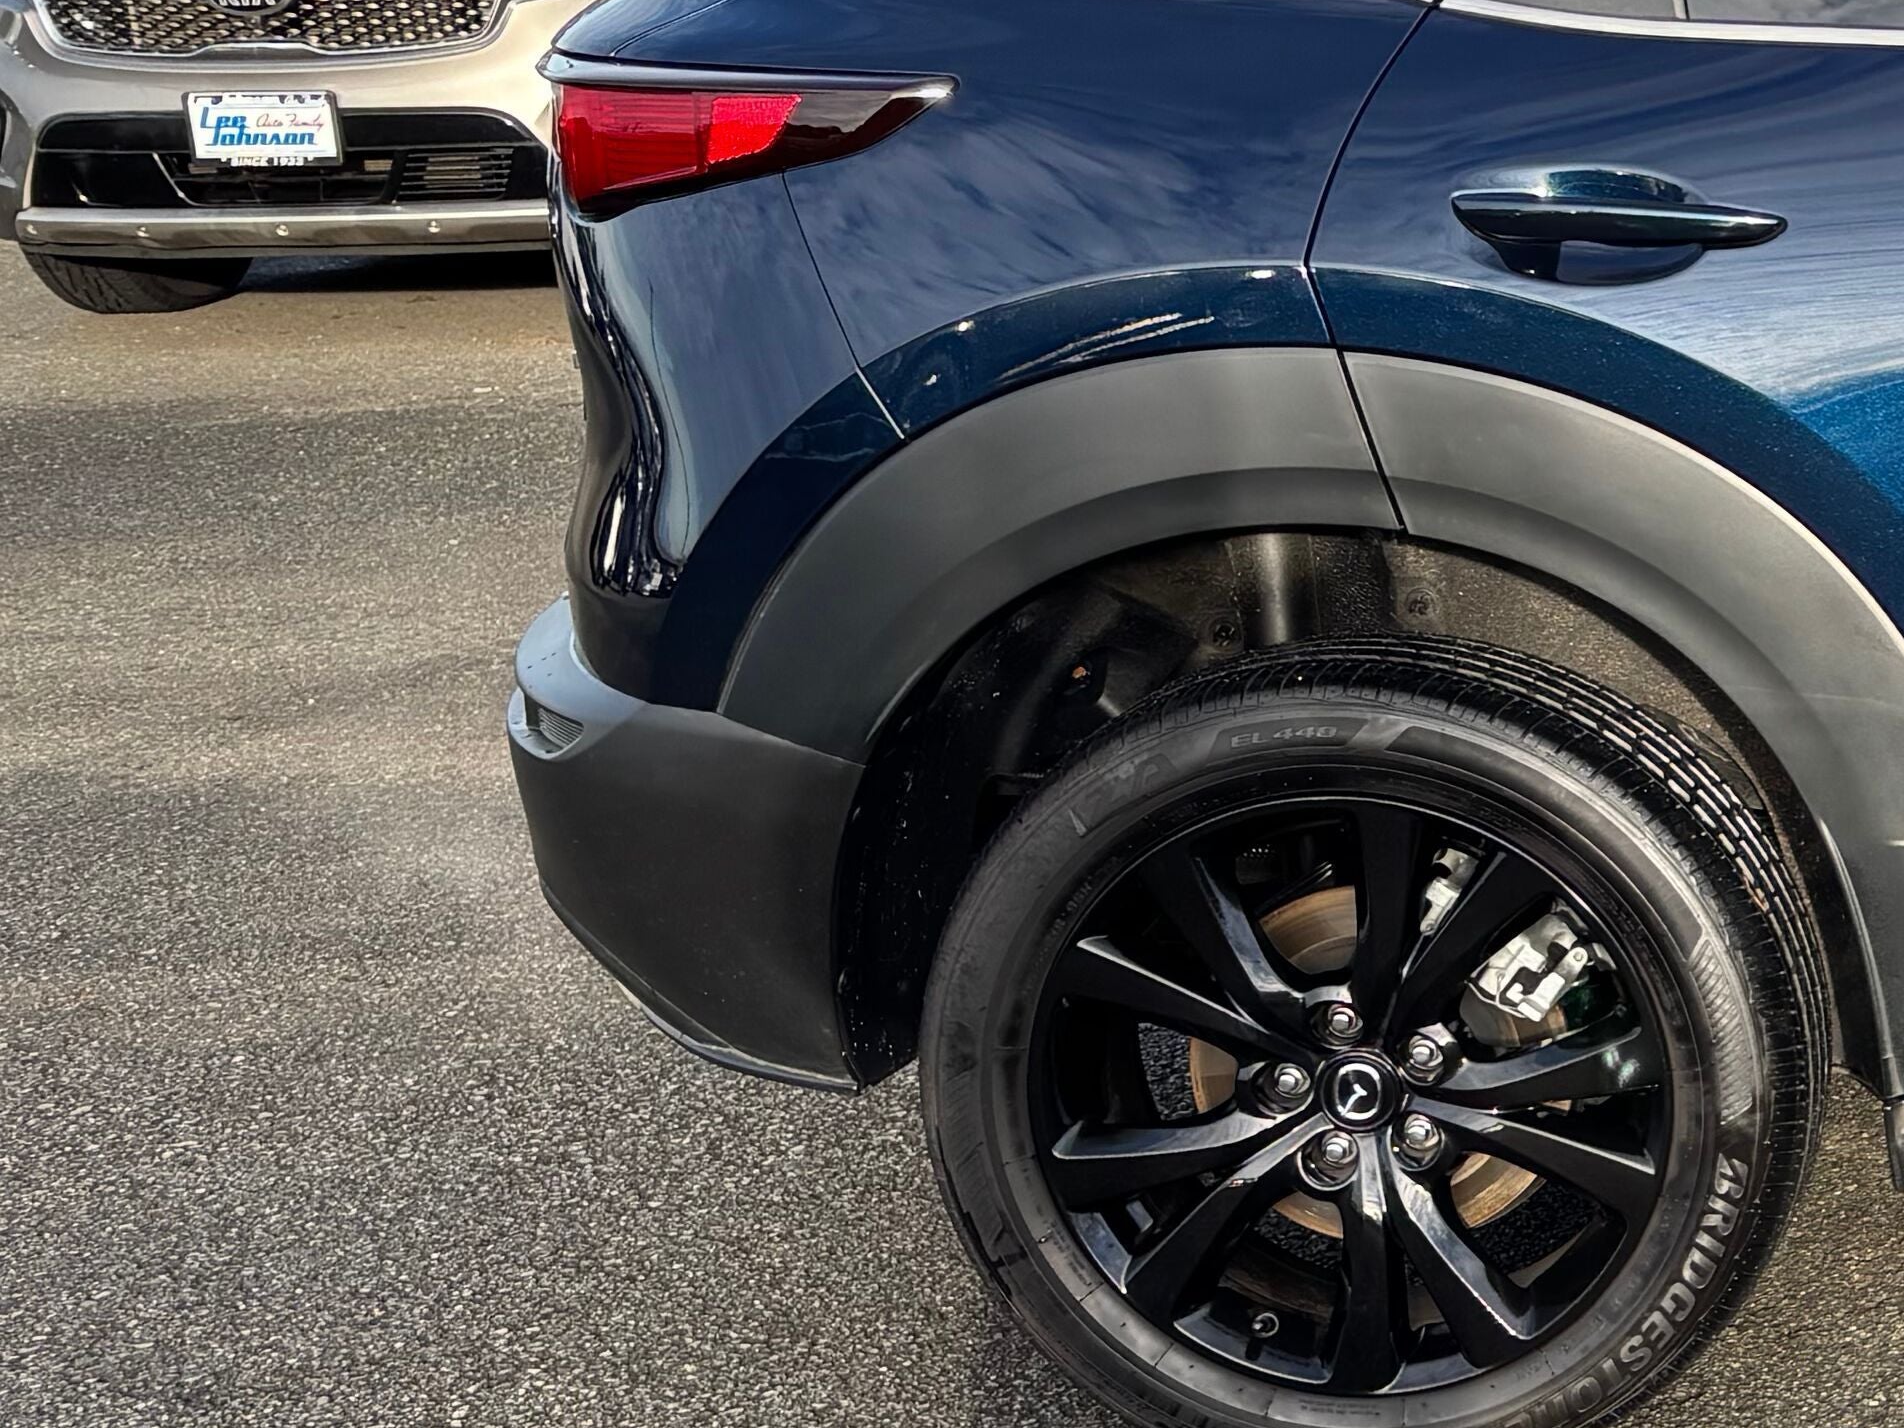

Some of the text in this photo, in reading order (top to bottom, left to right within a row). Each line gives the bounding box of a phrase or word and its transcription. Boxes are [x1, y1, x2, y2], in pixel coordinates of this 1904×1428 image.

[200, 106, 248, 129] Lee
[205, 125, 318, 146] Johnson
[1231, 732, 1269, 748] EL
